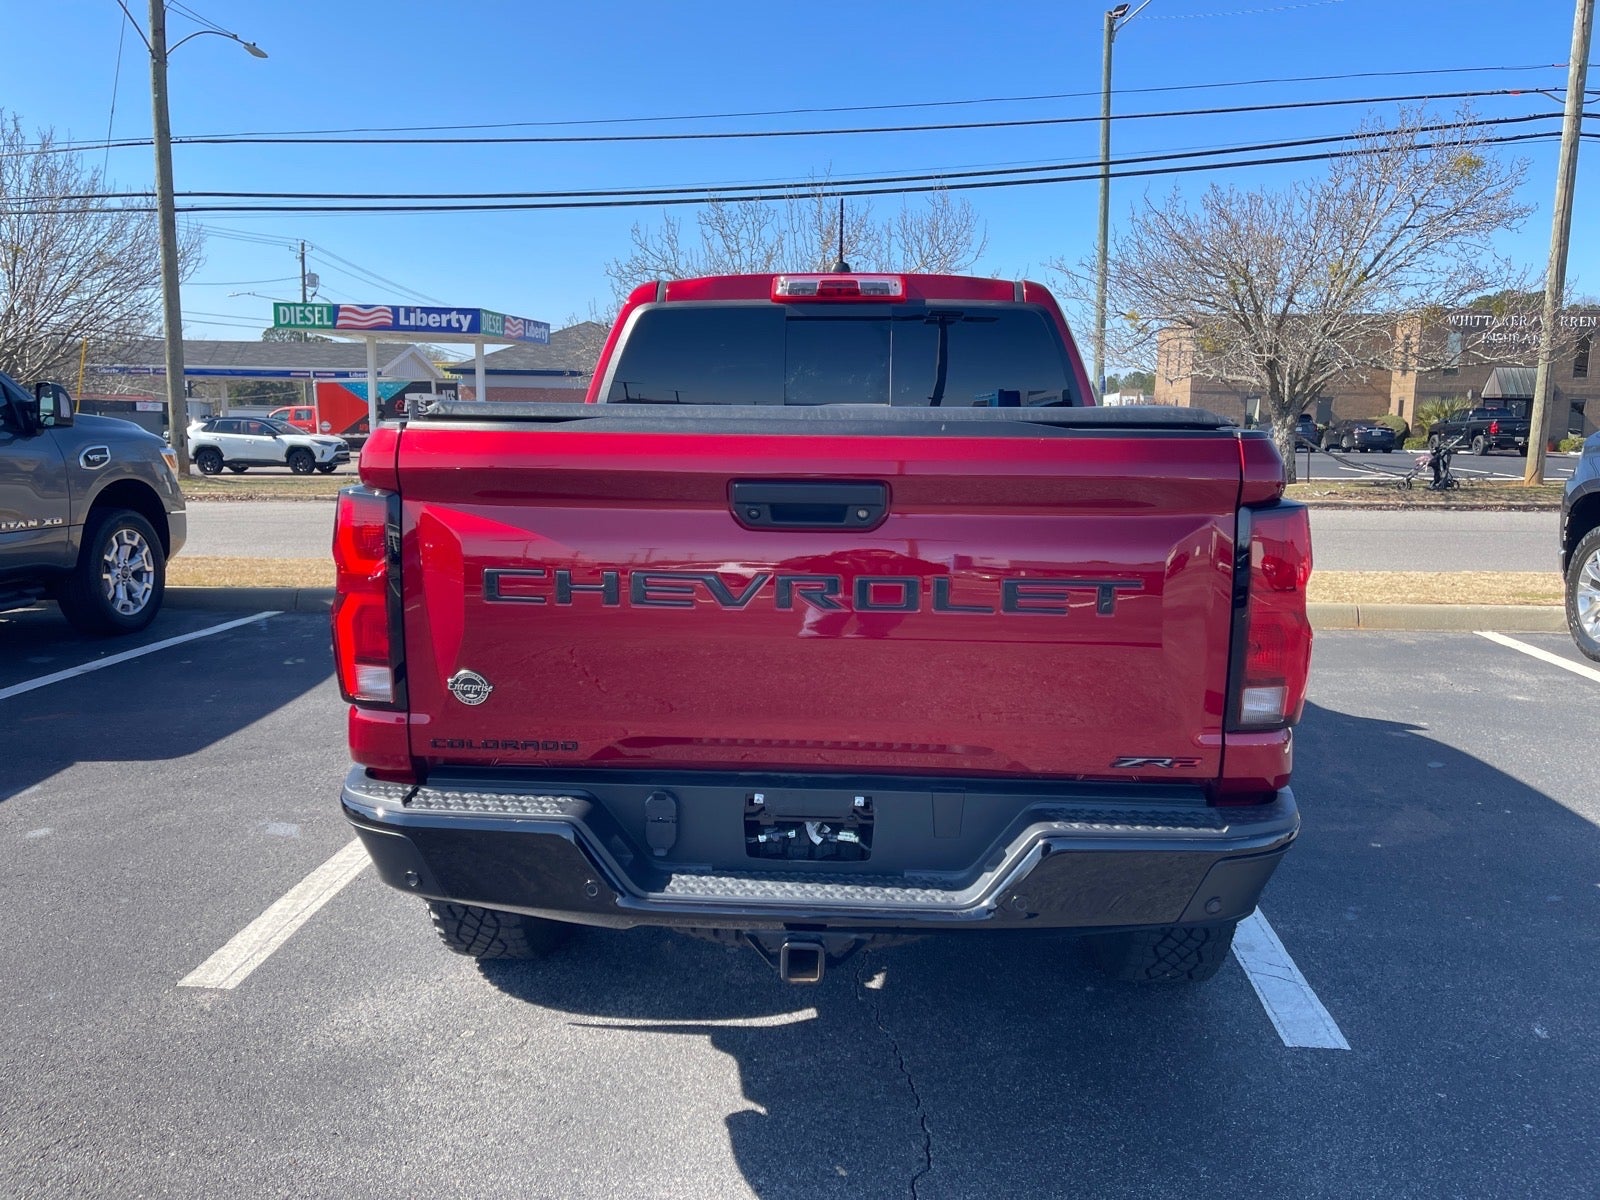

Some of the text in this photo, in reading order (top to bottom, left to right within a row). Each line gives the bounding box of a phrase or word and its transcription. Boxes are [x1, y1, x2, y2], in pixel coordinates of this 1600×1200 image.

[279, 305, 332, 326] DIESEL
[399, 306, 472, 332] Liberty
[482, 312, 503, 334] DIESEL
[525, 320, 549, 344] Liberty
[0, 517, 63, 529] ITAN XD
[482, 567, 1144, 617] CHEVROLET
[447, 678, 493, 694] Enterprise
[430, 737, 579, 752] COLORADO
[1109, 756, 1203, 769] ZR2
